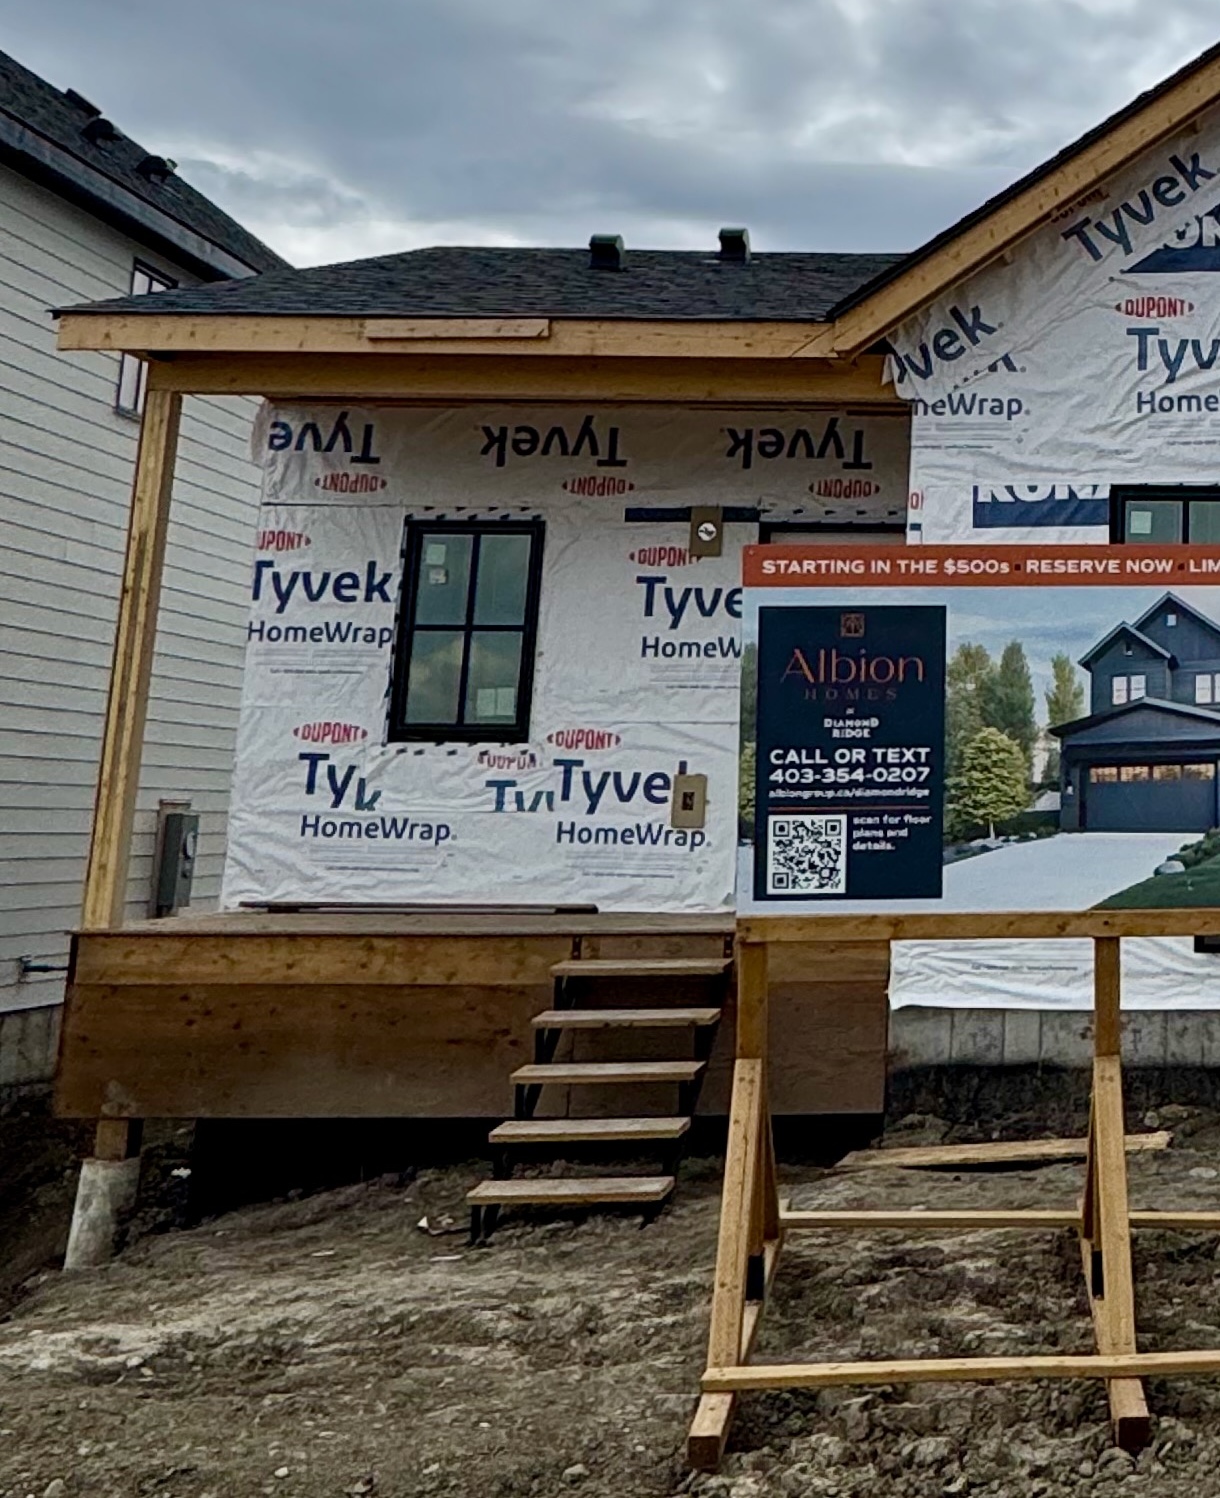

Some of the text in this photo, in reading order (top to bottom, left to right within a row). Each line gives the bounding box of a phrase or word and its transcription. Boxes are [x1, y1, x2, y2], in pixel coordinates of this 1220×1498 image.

[1062, 152, 1218, 261] Tyvek
[1125, 297, 1185, 318] DUPONT
[268, 411, 381, 464] Tyve
[480, 415, 627, 467] Tyvek
[725, 417, 872, 469] Tyvek
[322, 473, 378, 493] DUPONT
[570, 476, 625, 496] DUPONT
[817, 479, 871, 499] DUPONT
[762, 559, 865, 575] STARTING
[871, 559, 891, 574] IN
[896, 559, 938, 574] THE
[944, 558, 1010, 576] $500s
[1026, 559, 1120, 574] RESERVE
[1126, 559, 1173, 574] NOW
[252, 560, 393, 614] Tyvek
[247, 621, 393, 648] HomeWrap
[781, 648, 924, 684] Albion
[804, 687, 897, 701] HOMES
[301, 722, 361, 743] DUPONT
[555, 729, 613, 750] DUPONT
[769, 747, 931, 765] CALL OR TEXT
[768, 767, 931, 784] 403-354-0207
[301, 815, 450, 846] HomeWrap
[556, 821, 705, 852] HomeWrap
